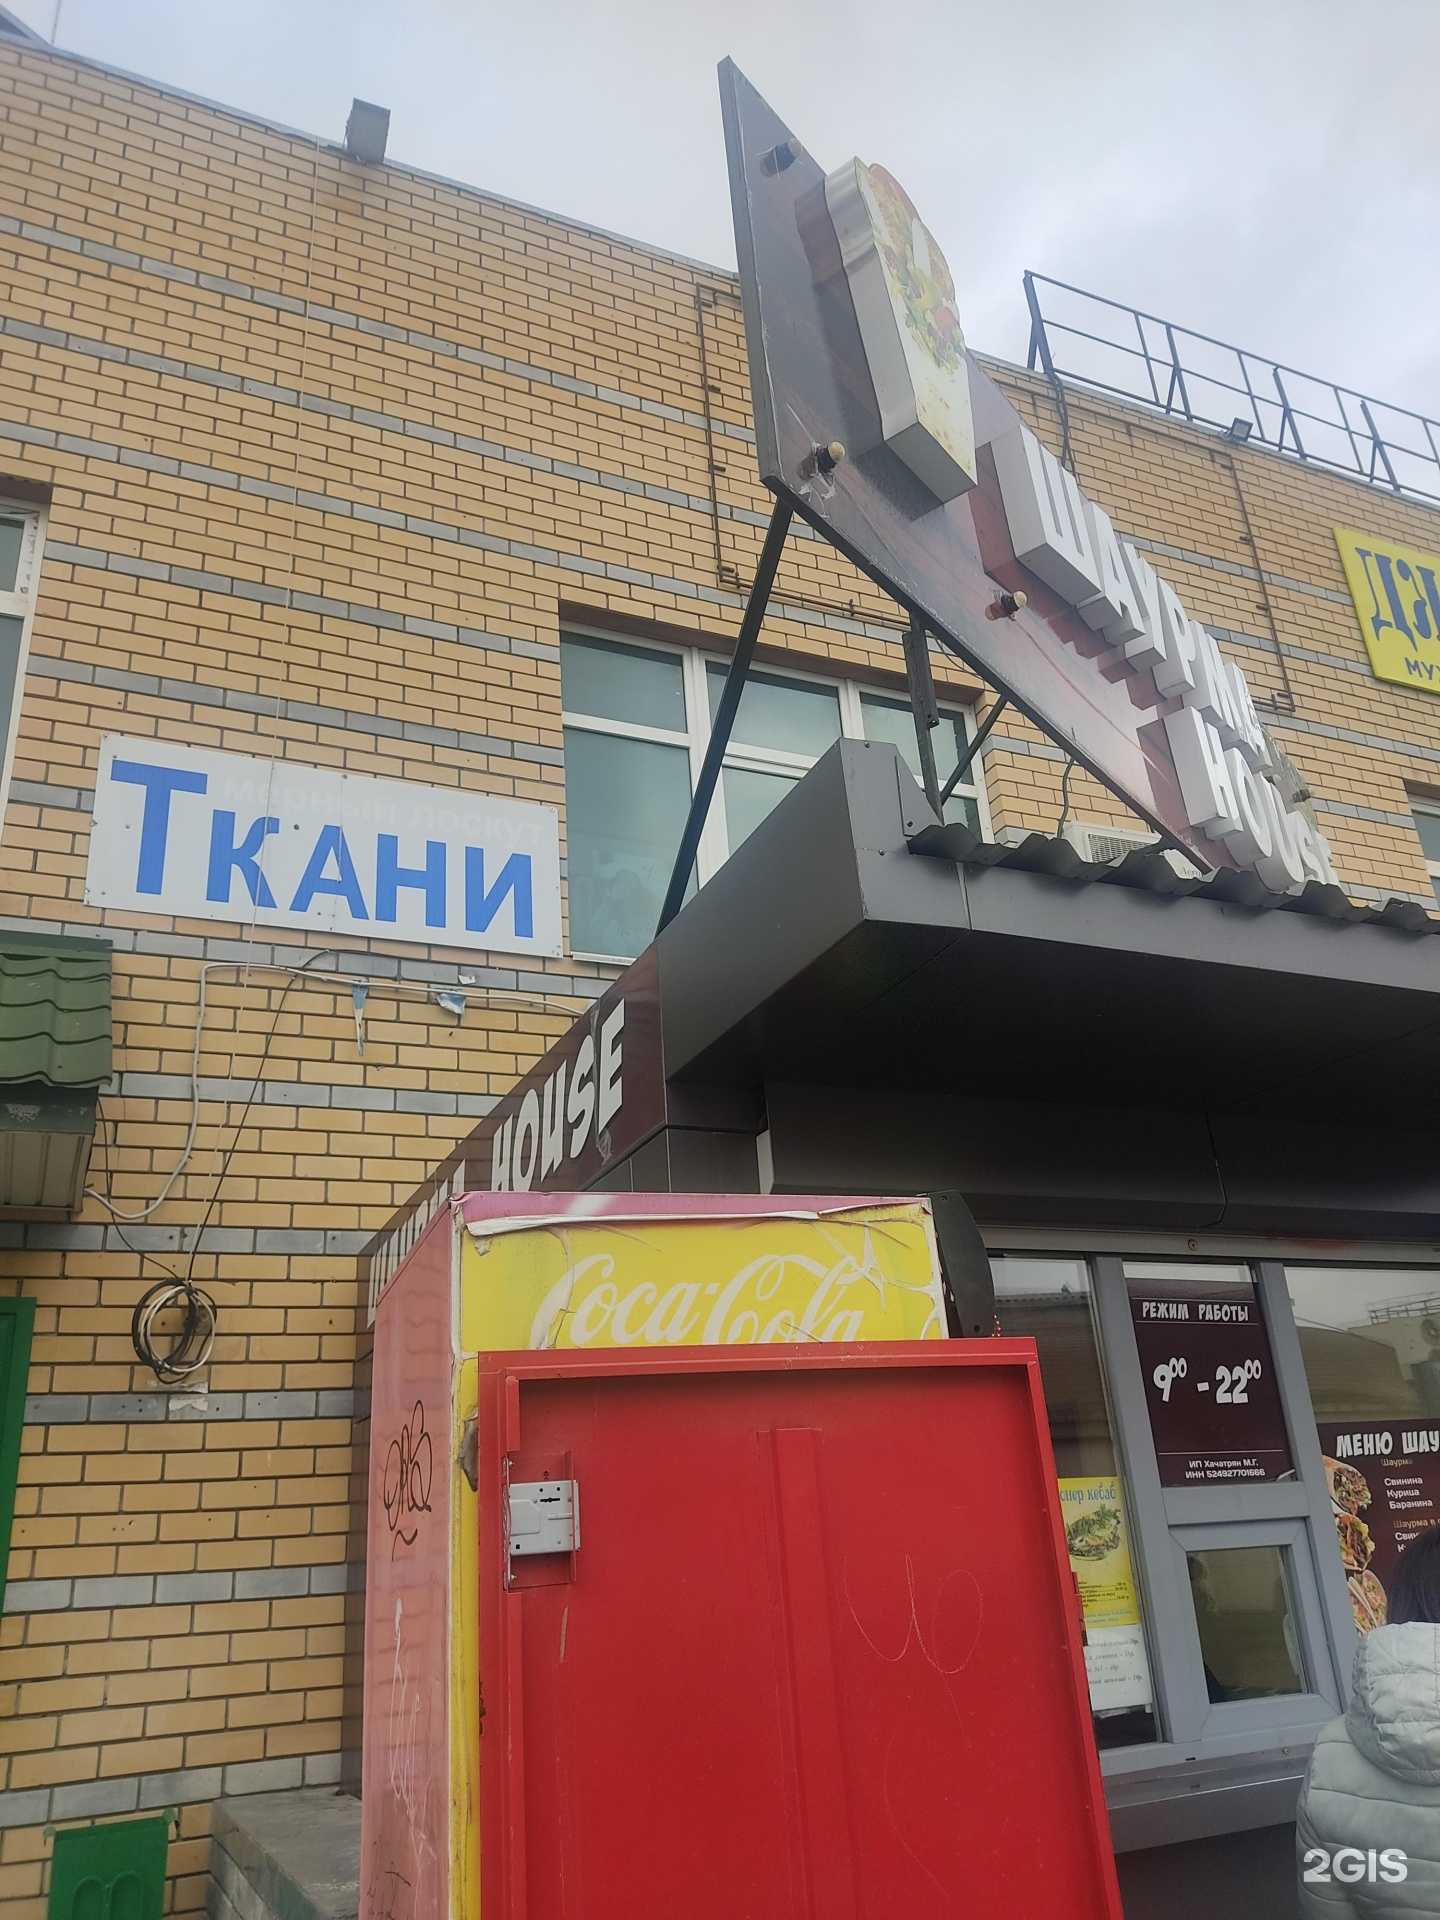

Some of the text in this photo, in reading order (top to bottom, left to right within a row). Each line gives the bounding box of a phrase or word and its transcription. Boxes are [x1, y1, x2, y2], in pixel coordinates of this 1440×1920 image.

[1405, 656, 1440, 681] МУ
[491, 998, 625, 1192] HOUSE
[1142, 1302, 1249, 1322] РЕЖИМ РАБОТЫ
[1336, 1431, 1394, 1458] МЕНЮ
[1188, 1460, 1202, 1468] ИП
[1204, 1459, 1241, 1468] Хачатрян
[1185, 1470, 1205, 1479] ИНН
[1384, 1477, 1424, 1487] Свинина
[1386, 1488, 1420, 1499] Курица
[1389, 1499, 1433, 1510] Баранина
